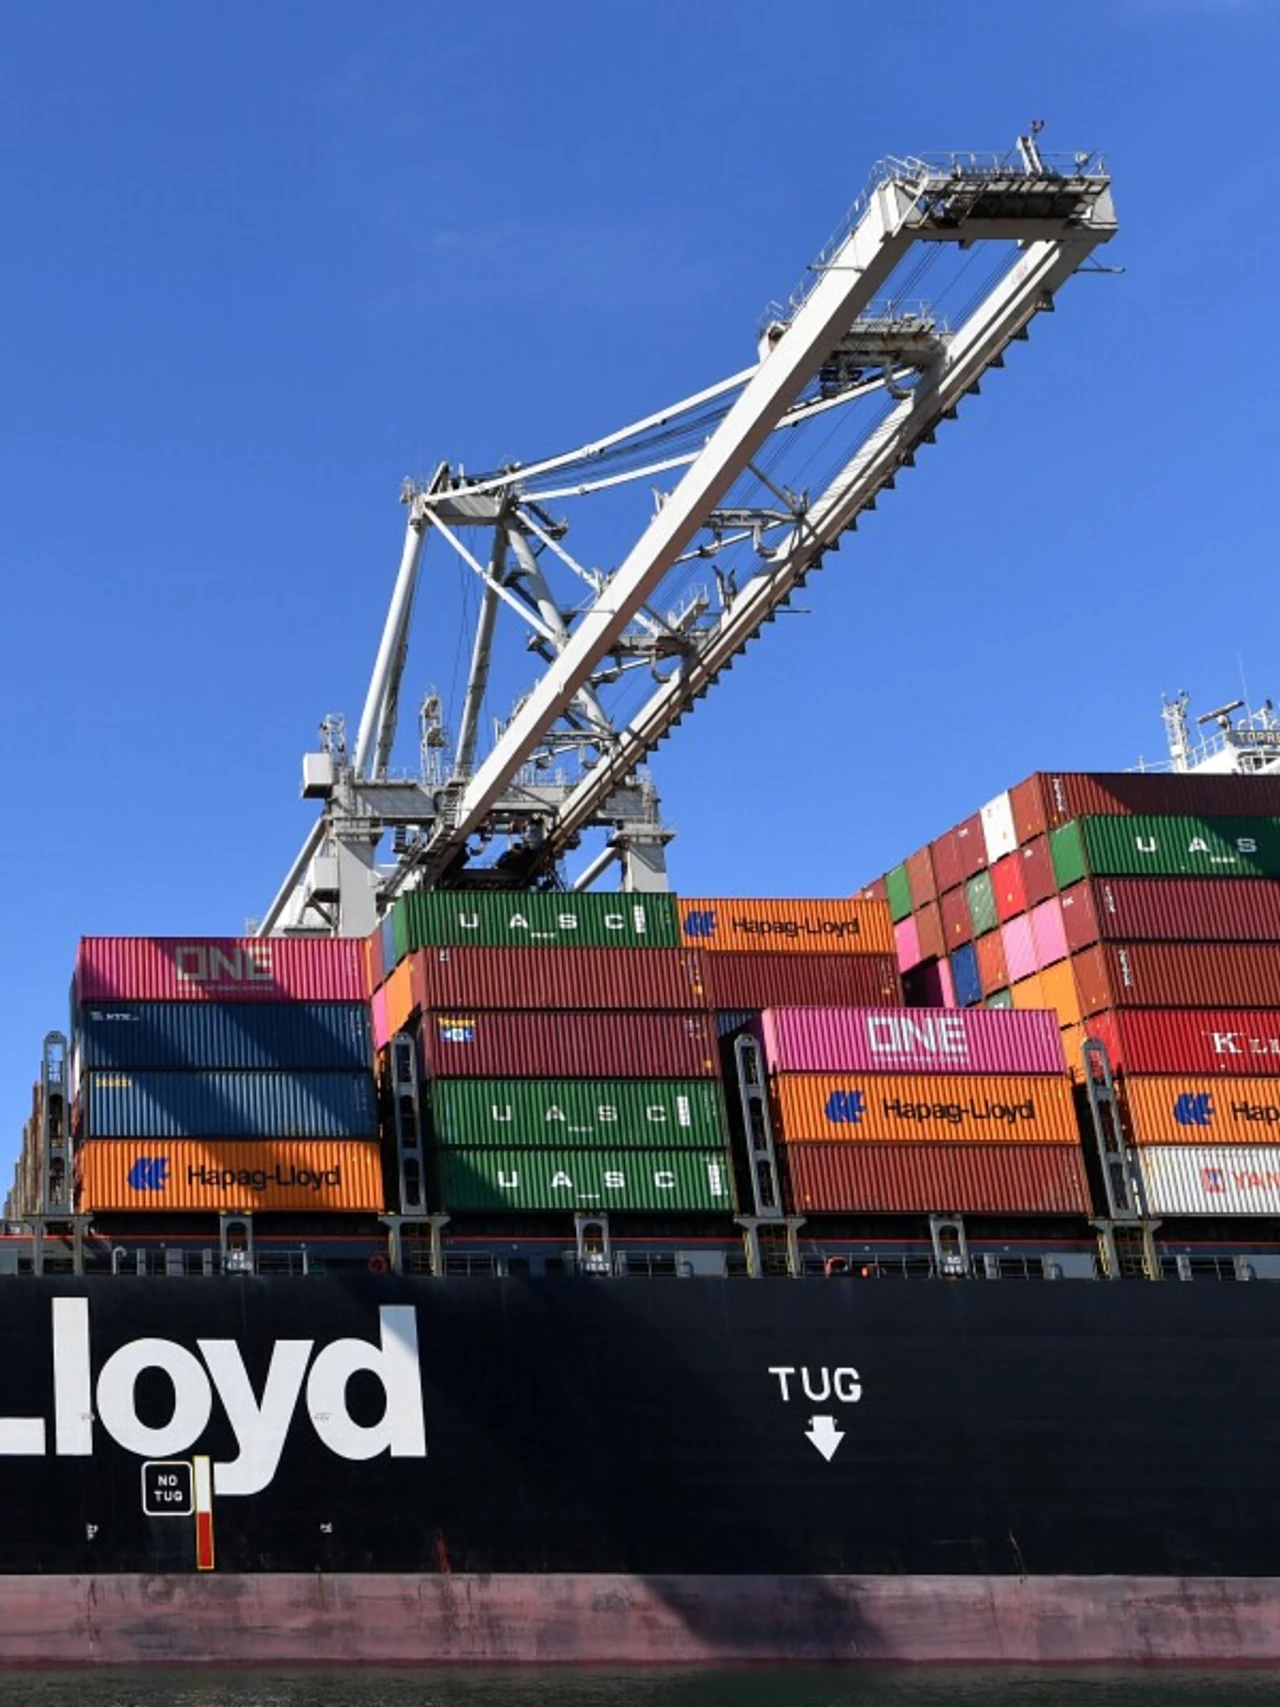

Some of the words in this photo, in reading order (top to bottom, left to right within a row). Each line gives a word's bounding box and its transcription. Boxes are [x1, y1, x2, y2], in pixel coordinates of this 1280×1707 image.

[732, 917, 860, 937] Hapag-Lloyd
[175, 946, 274, 981] ONE
[867, 1015, 968, 1052] ONE
[883, 1098, 1036, 1123] Hapag-Lloyd
[187, 1165, 341, 1190] Hapag-Lloyd
[768, 1367, 862, 1402] TUG
[157, 1475, 178, 1486] NO
[154, 1491, 183, 1502] TUG
